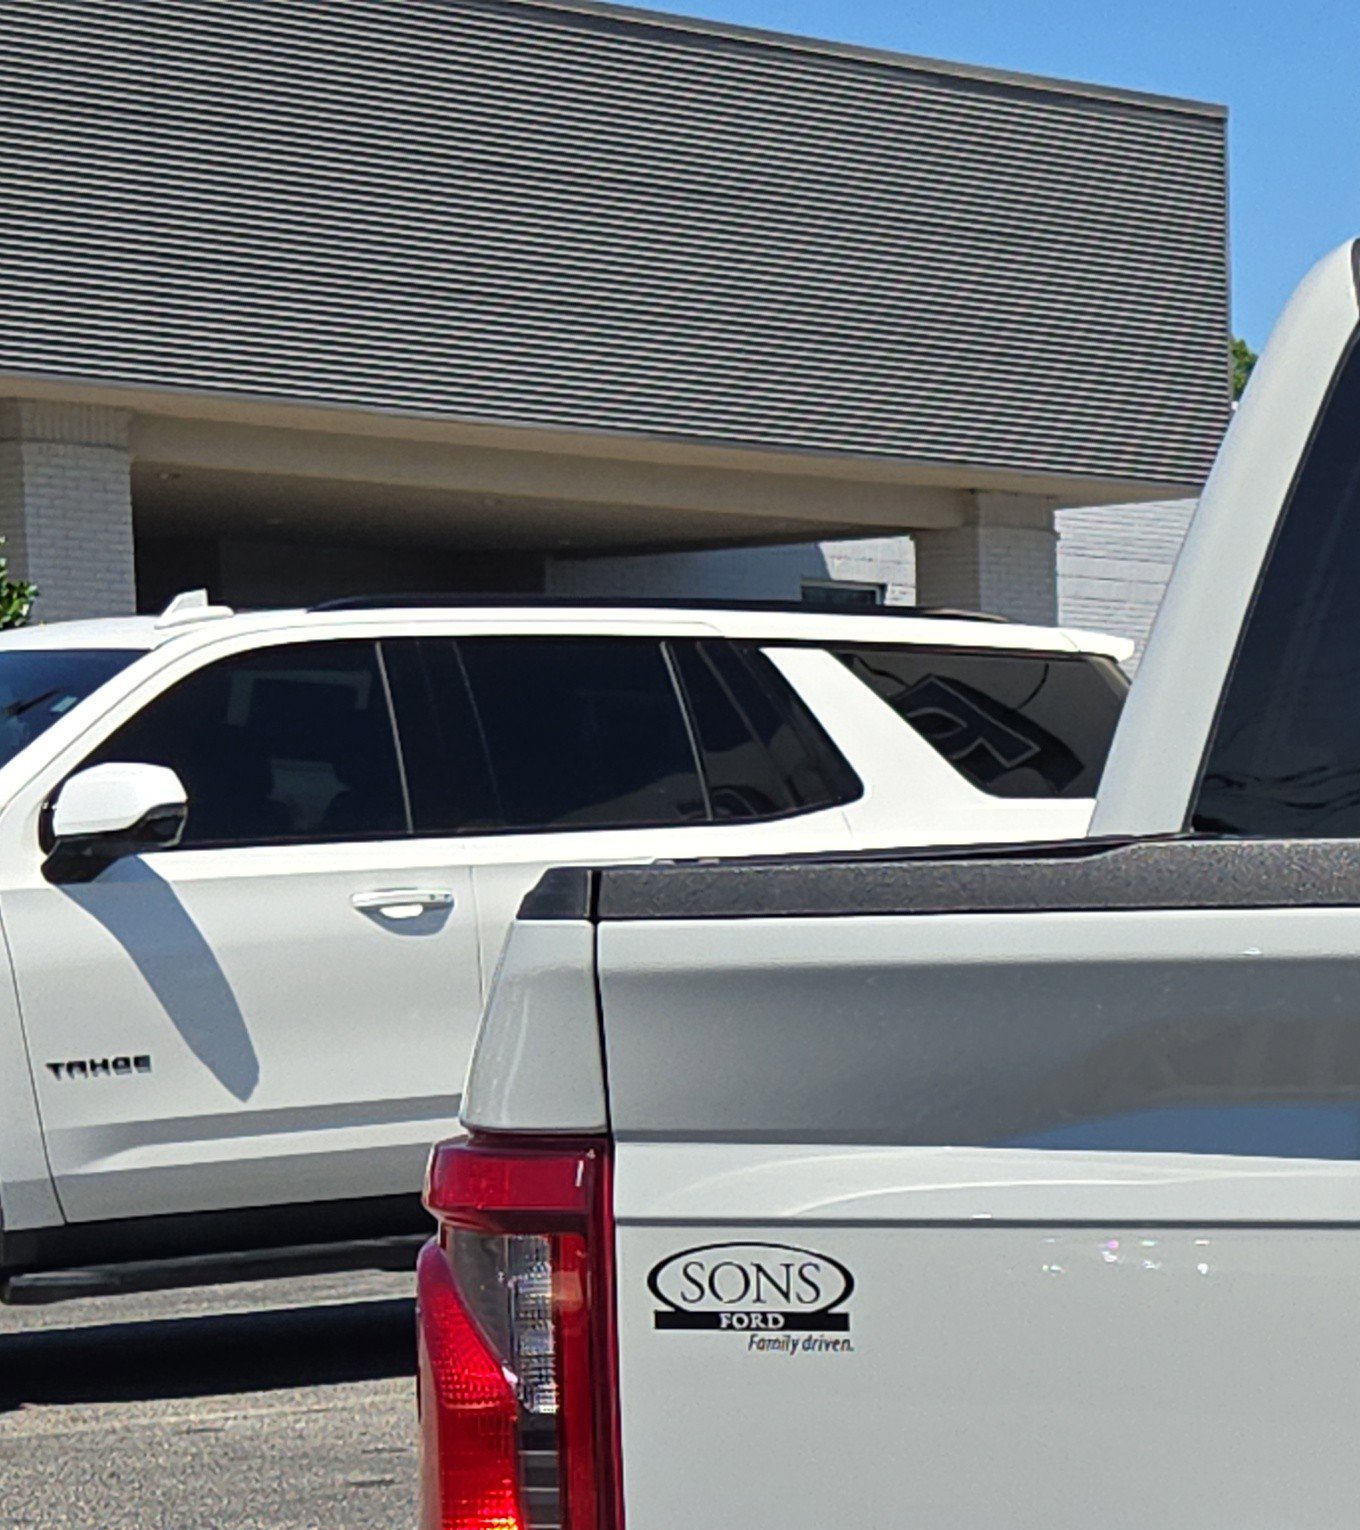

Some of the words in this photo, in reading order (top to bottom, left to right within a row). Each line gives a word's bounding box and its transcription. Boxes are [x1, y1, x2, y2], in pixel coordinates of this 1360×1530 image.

[45, 1055, 153, 1081] TAHOE
[680, 1261, 821, 1304] SONS
[719, 1312, 785, 1329] FORD
[748, 1333, 802, 1356] Family
[802, 1334, 855, 1352] driven.
